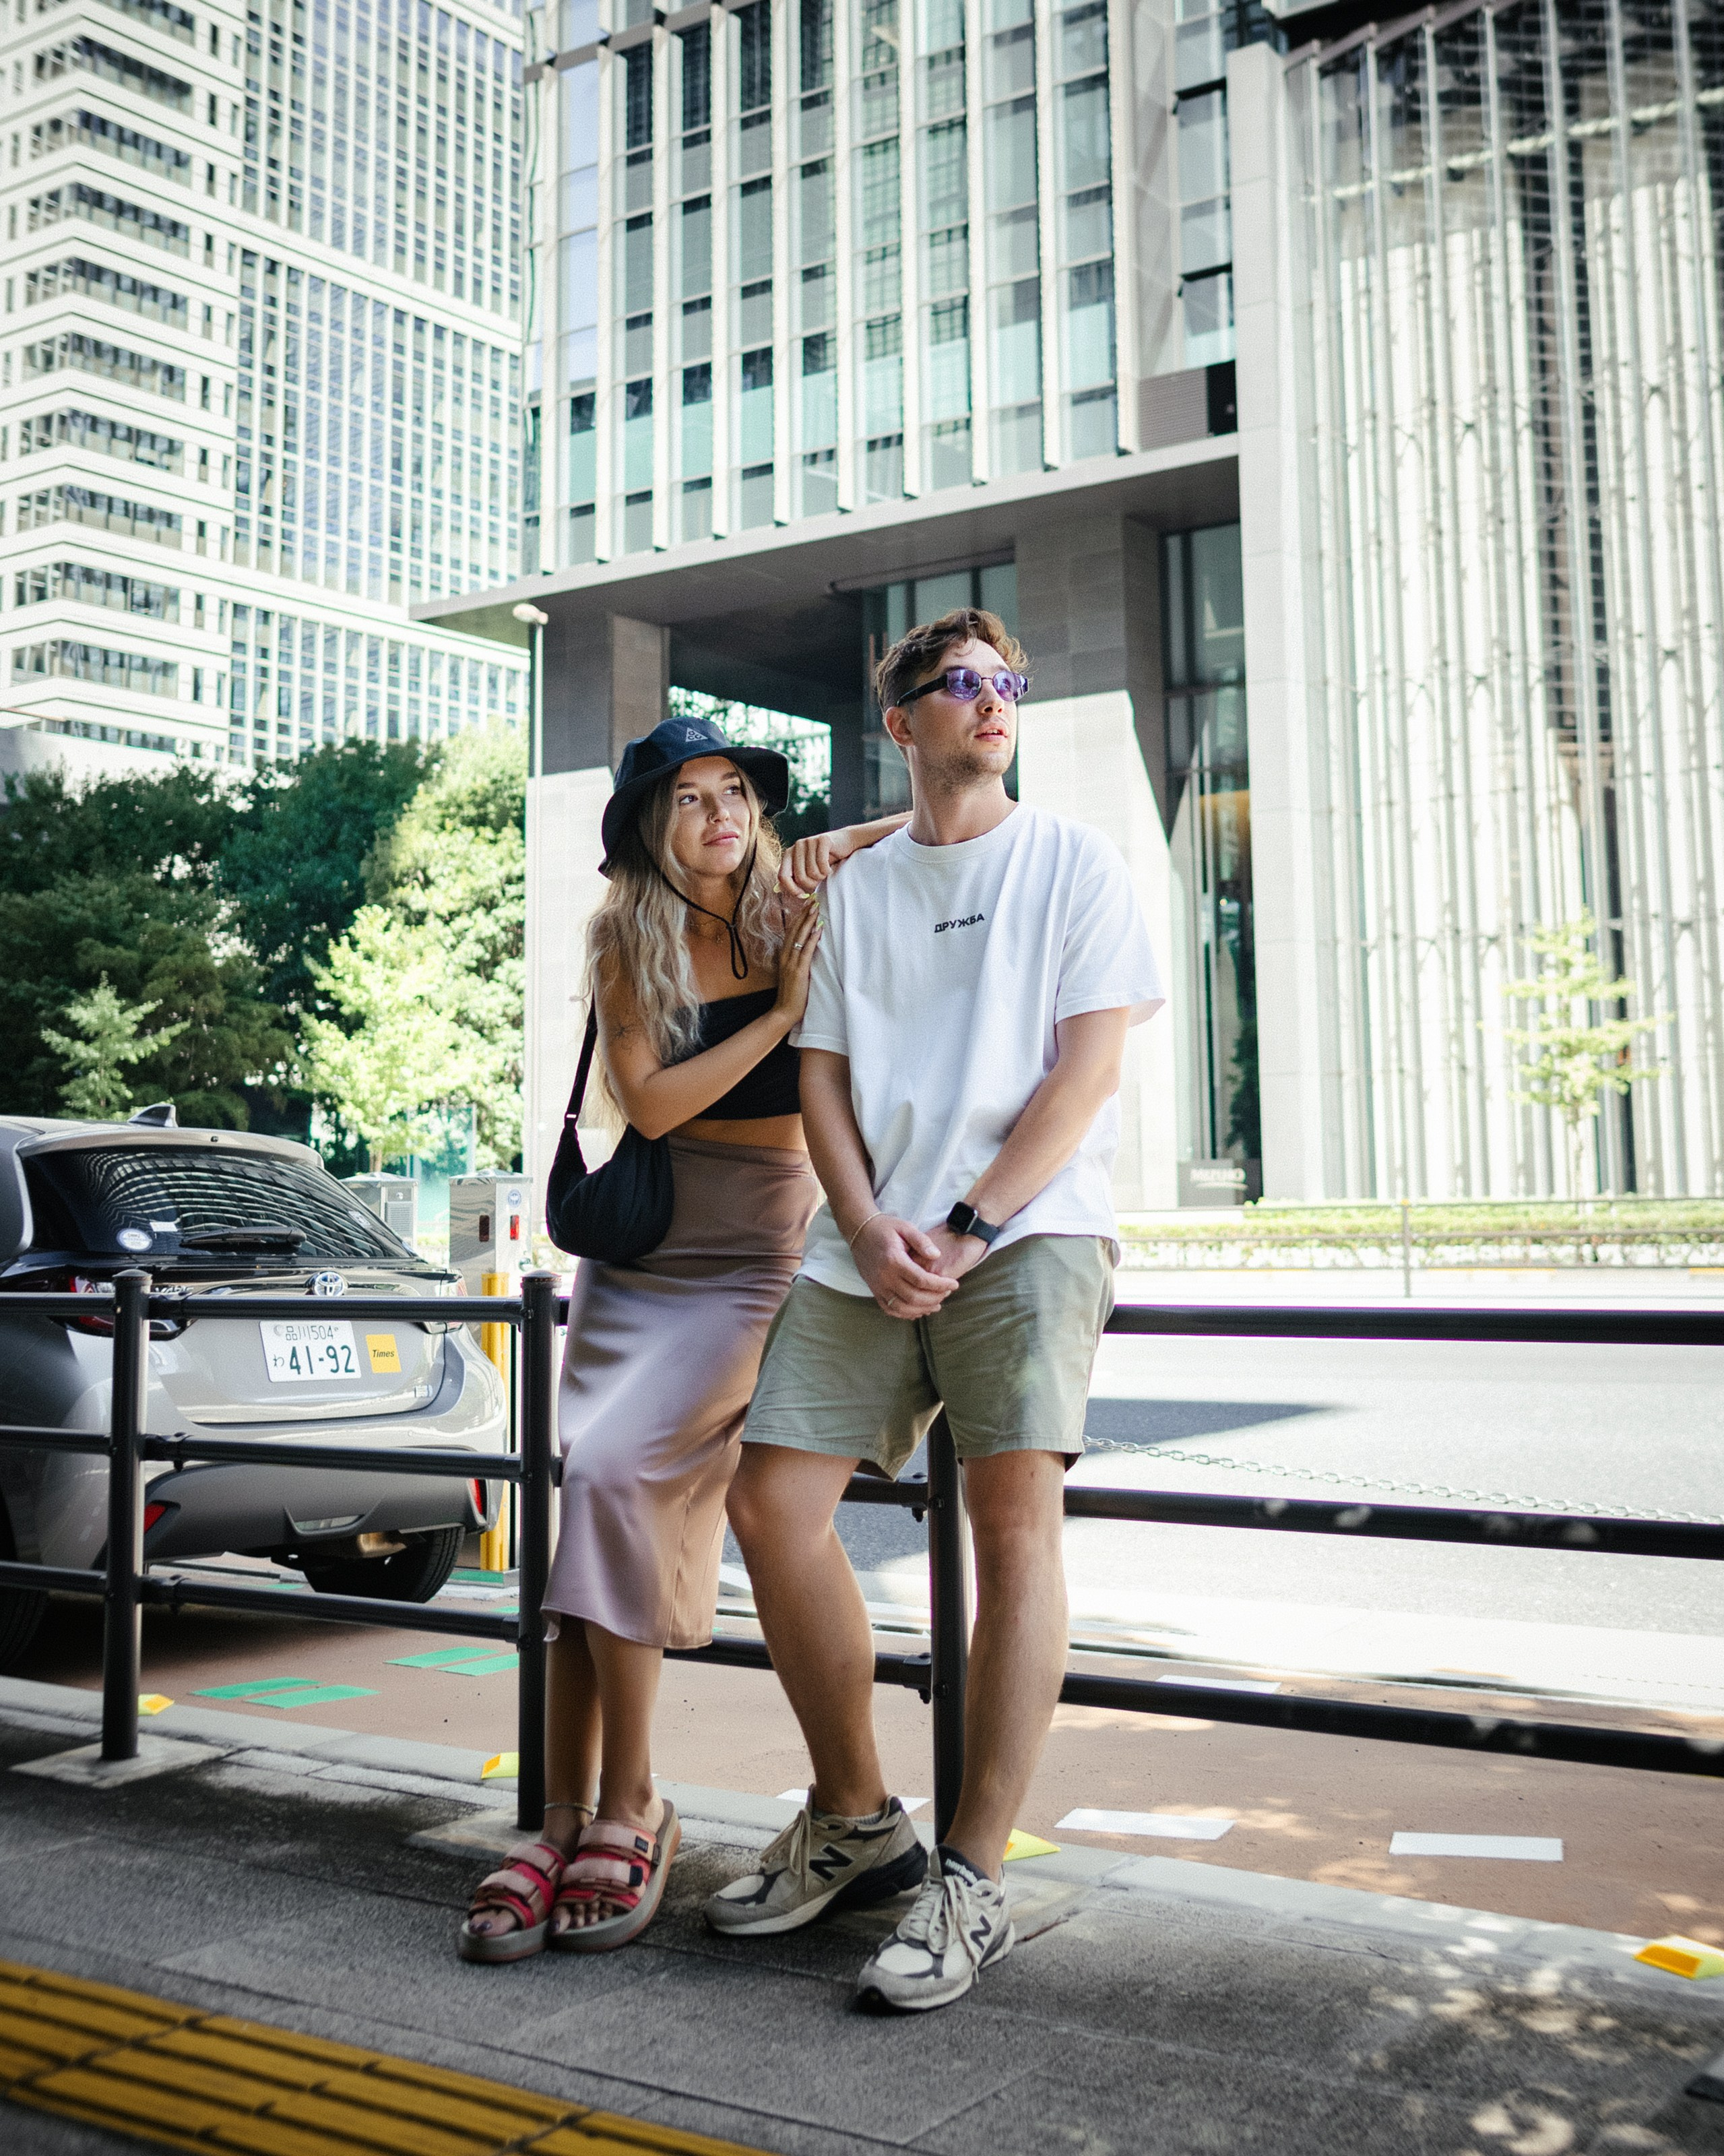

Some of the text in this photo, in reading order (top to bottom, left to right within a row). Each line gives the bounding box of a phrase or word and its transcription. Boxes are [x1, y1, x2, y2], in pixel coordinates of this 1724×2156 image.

[934, 913, 985, 933] ДРУЖБА
[272, 1344, 355, 1375] わ 41-92
[372, 1349, 395, 1358] Times
